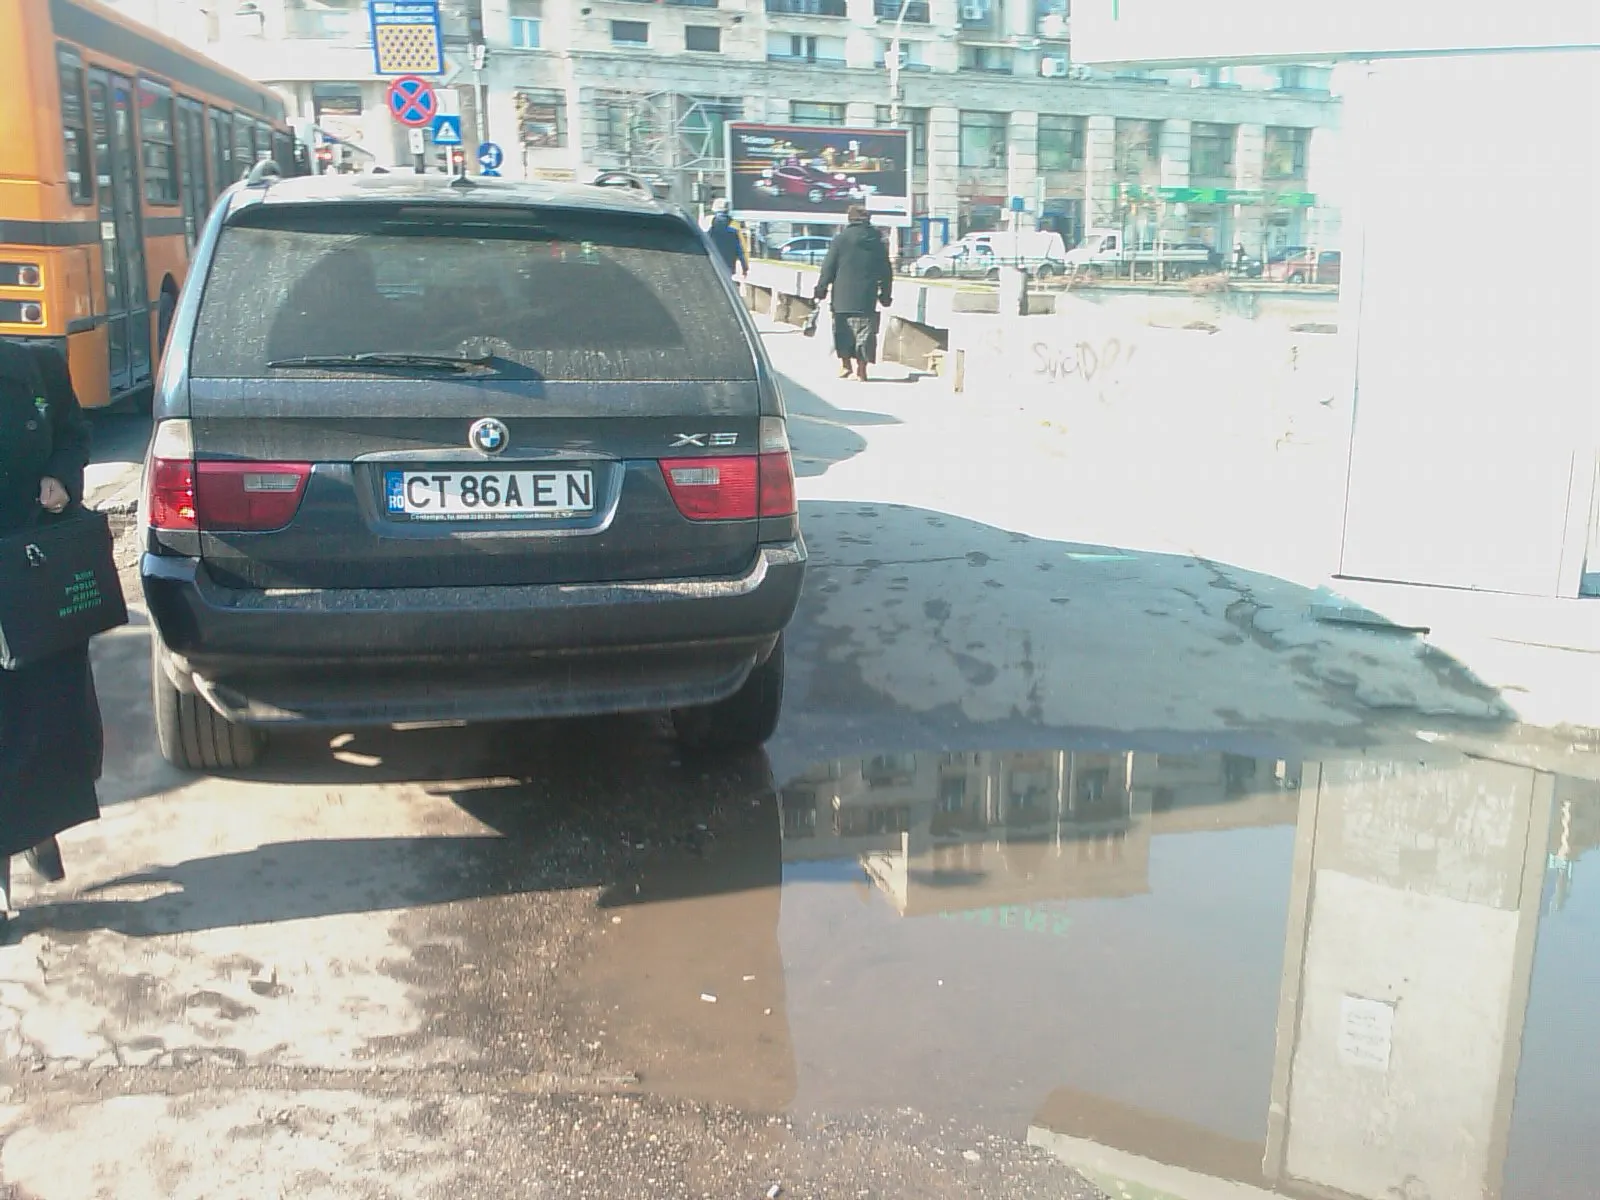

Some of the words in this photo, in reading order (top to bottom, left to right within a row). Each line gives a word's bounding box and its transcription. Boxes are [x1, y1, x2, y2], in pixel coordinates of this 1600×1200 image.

[669, 432, 739, 447] X5
[406, 475, 452, 508] CT
[389, 494, 404, 509] RO
